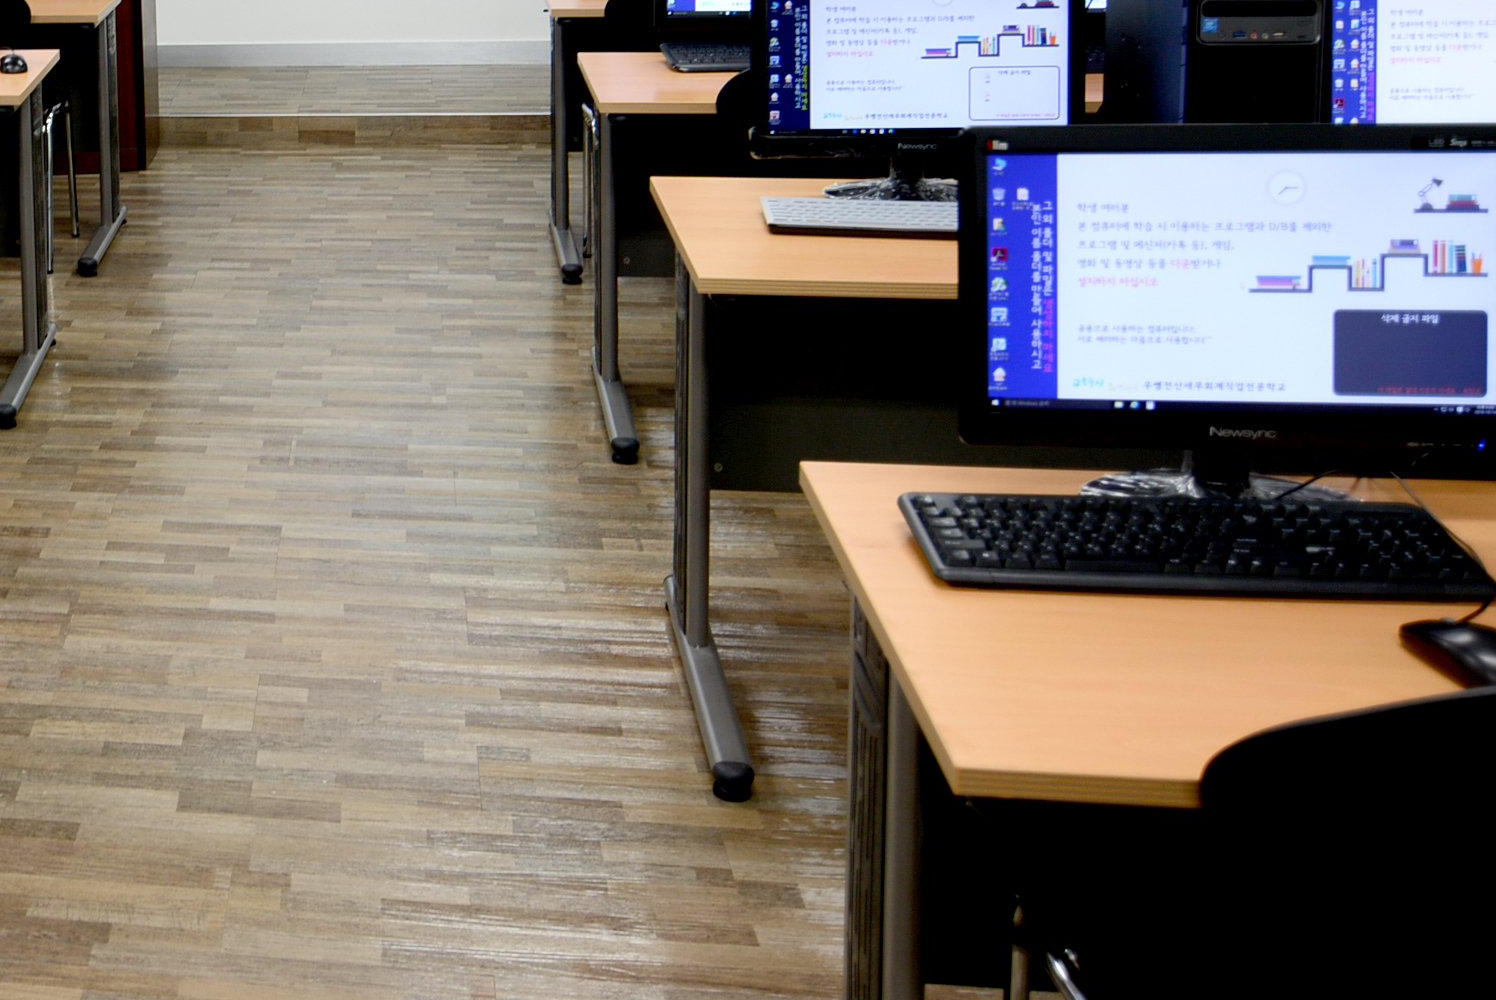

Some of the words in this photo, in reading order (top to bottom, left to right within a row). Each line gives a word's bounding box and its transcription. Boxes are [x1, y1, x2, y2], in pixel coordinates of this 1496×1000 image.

[898, 142, 937, 150] Newsync
[1077, 203, 1097, 214] 학생
[1100, 203, 1130, 214] 여러분
[1209, 426, 1277, 439] Newsync
